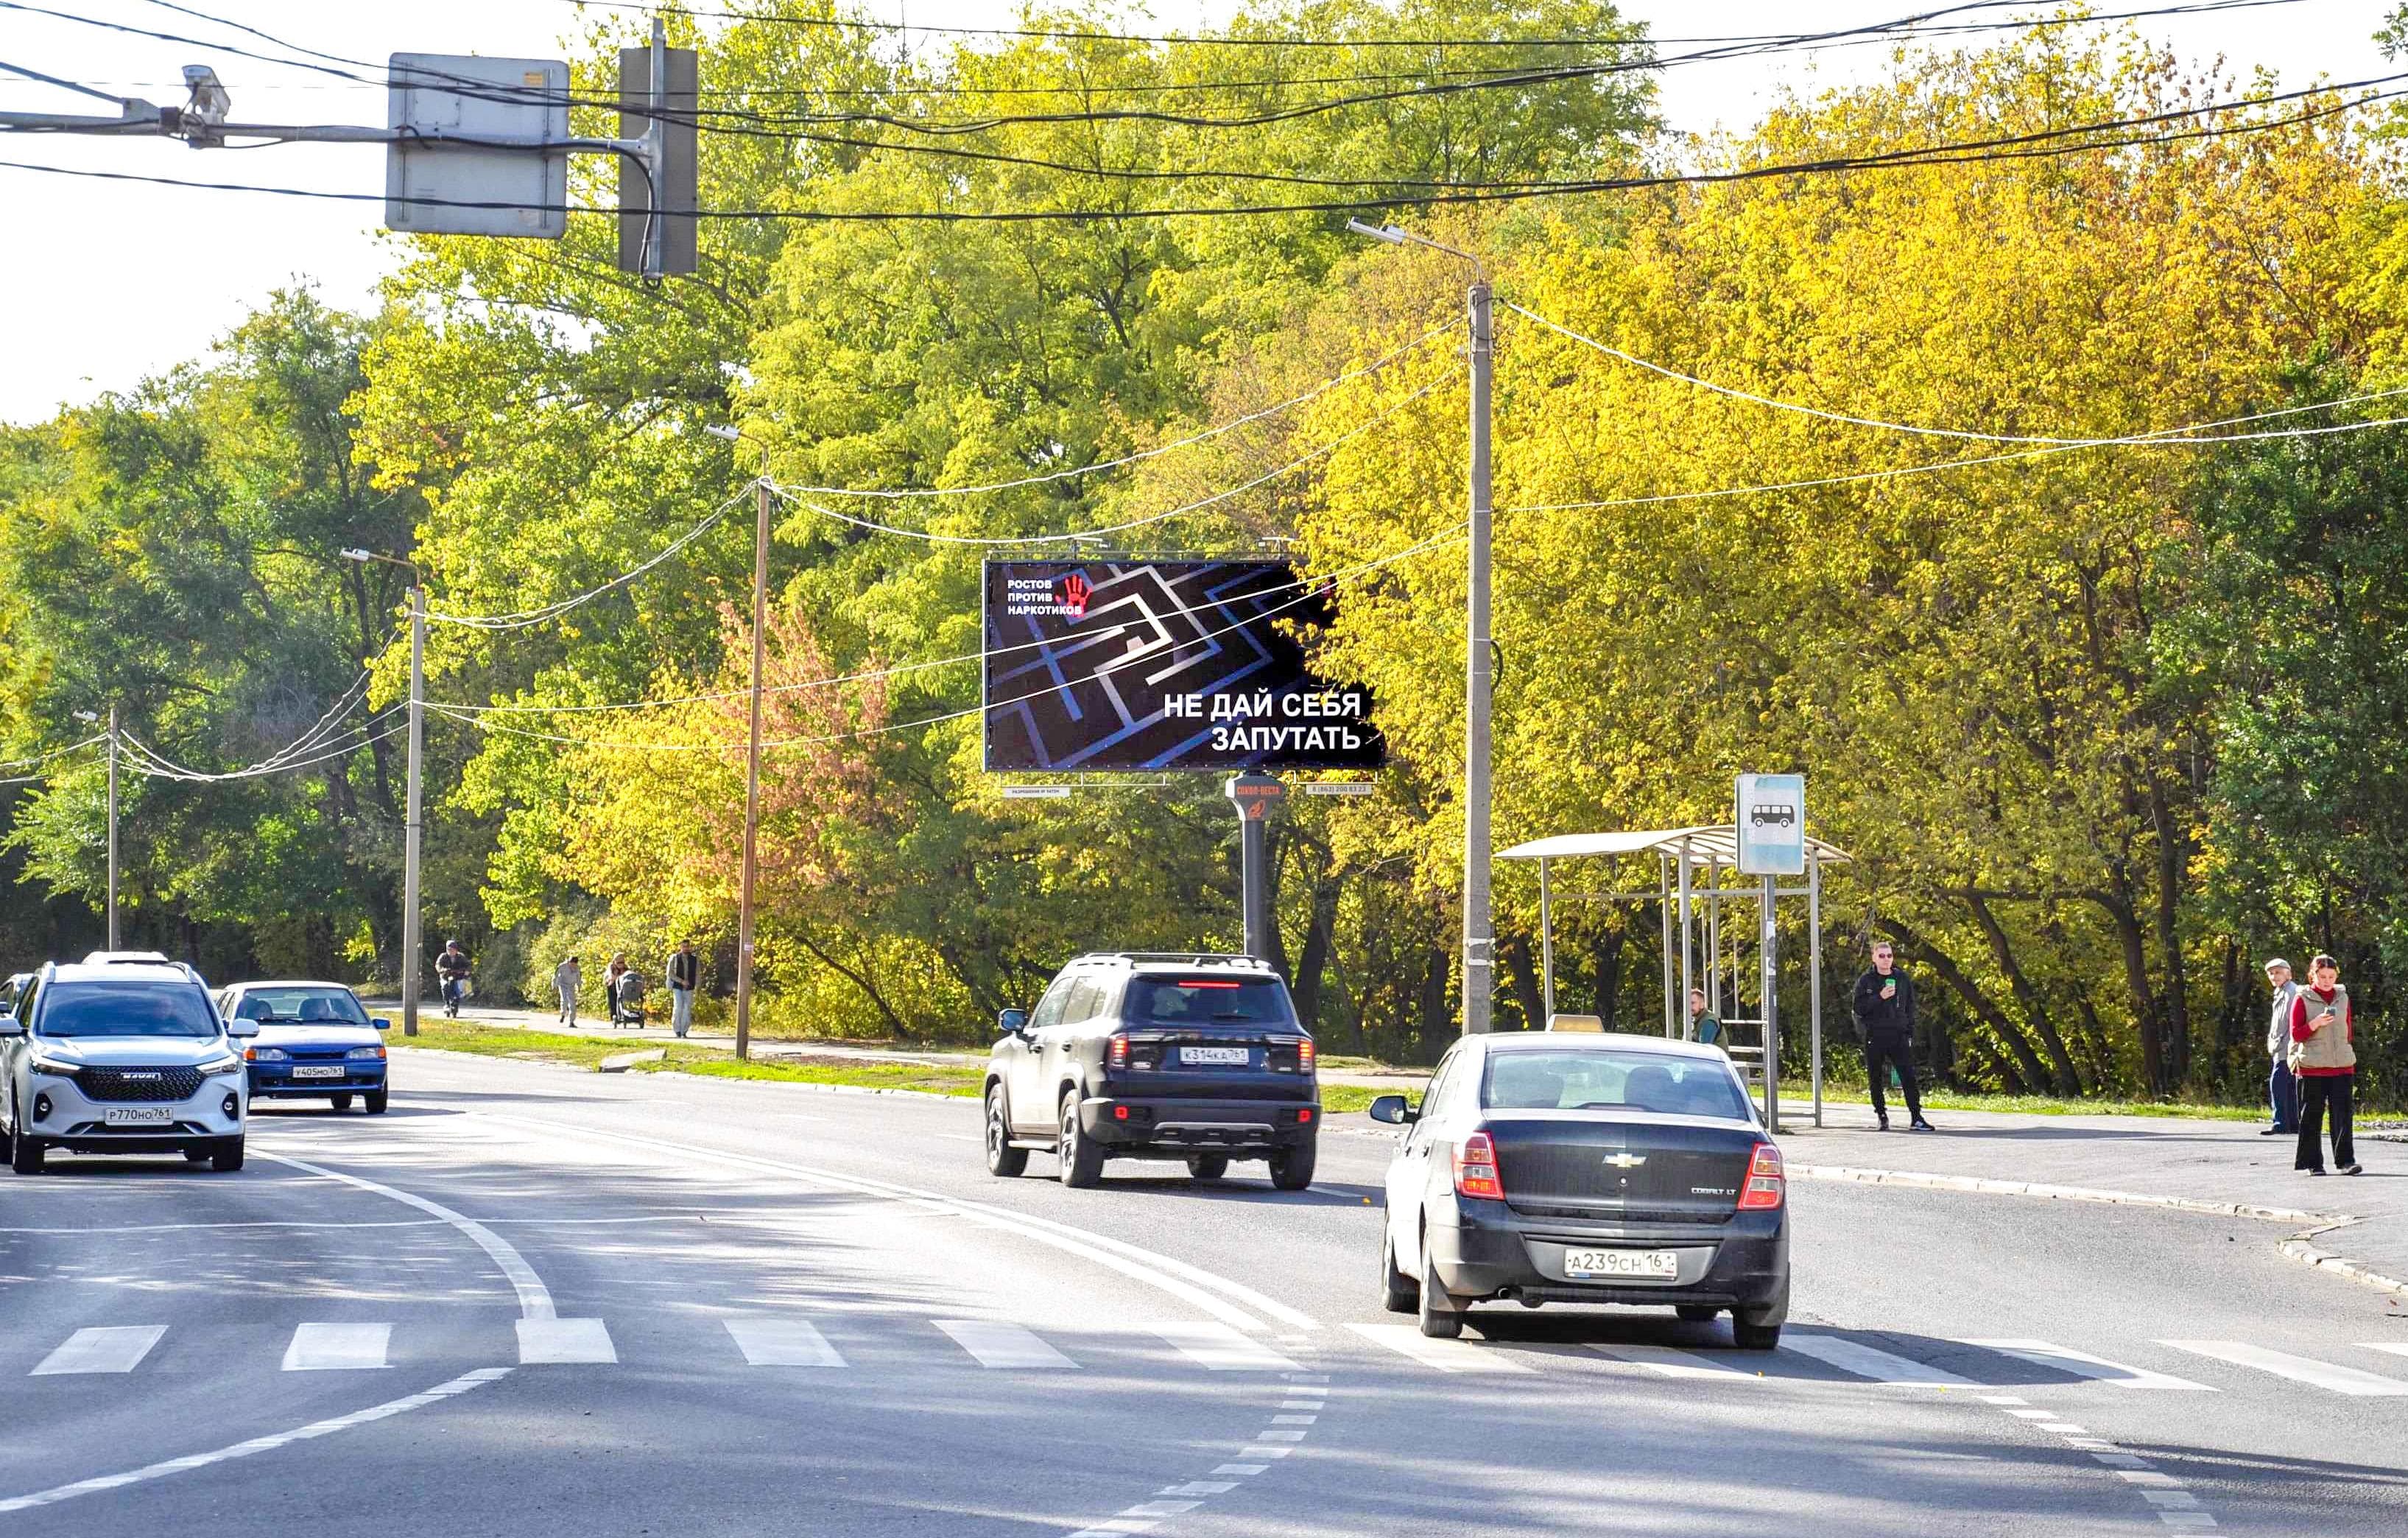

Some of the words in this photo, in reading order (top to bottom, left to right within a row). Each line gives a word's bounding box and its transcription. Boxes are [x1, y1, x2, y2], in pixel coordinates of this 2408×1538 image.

[1007, 580, 1052, 589] РОСТОВ
[1007, 592, 1053, 602] ПРОТИВ
[1007, 605, 1082, 615] НАРКОТИКОВ
[1164, 693, 1203, 717] НЕ
[1210, 687, 1272, 722] ДАЙ
[1281, 692, 1361, 717] СЕБЯ
[1211, 726, 1361, 751] ЗАПУТАТЬ
